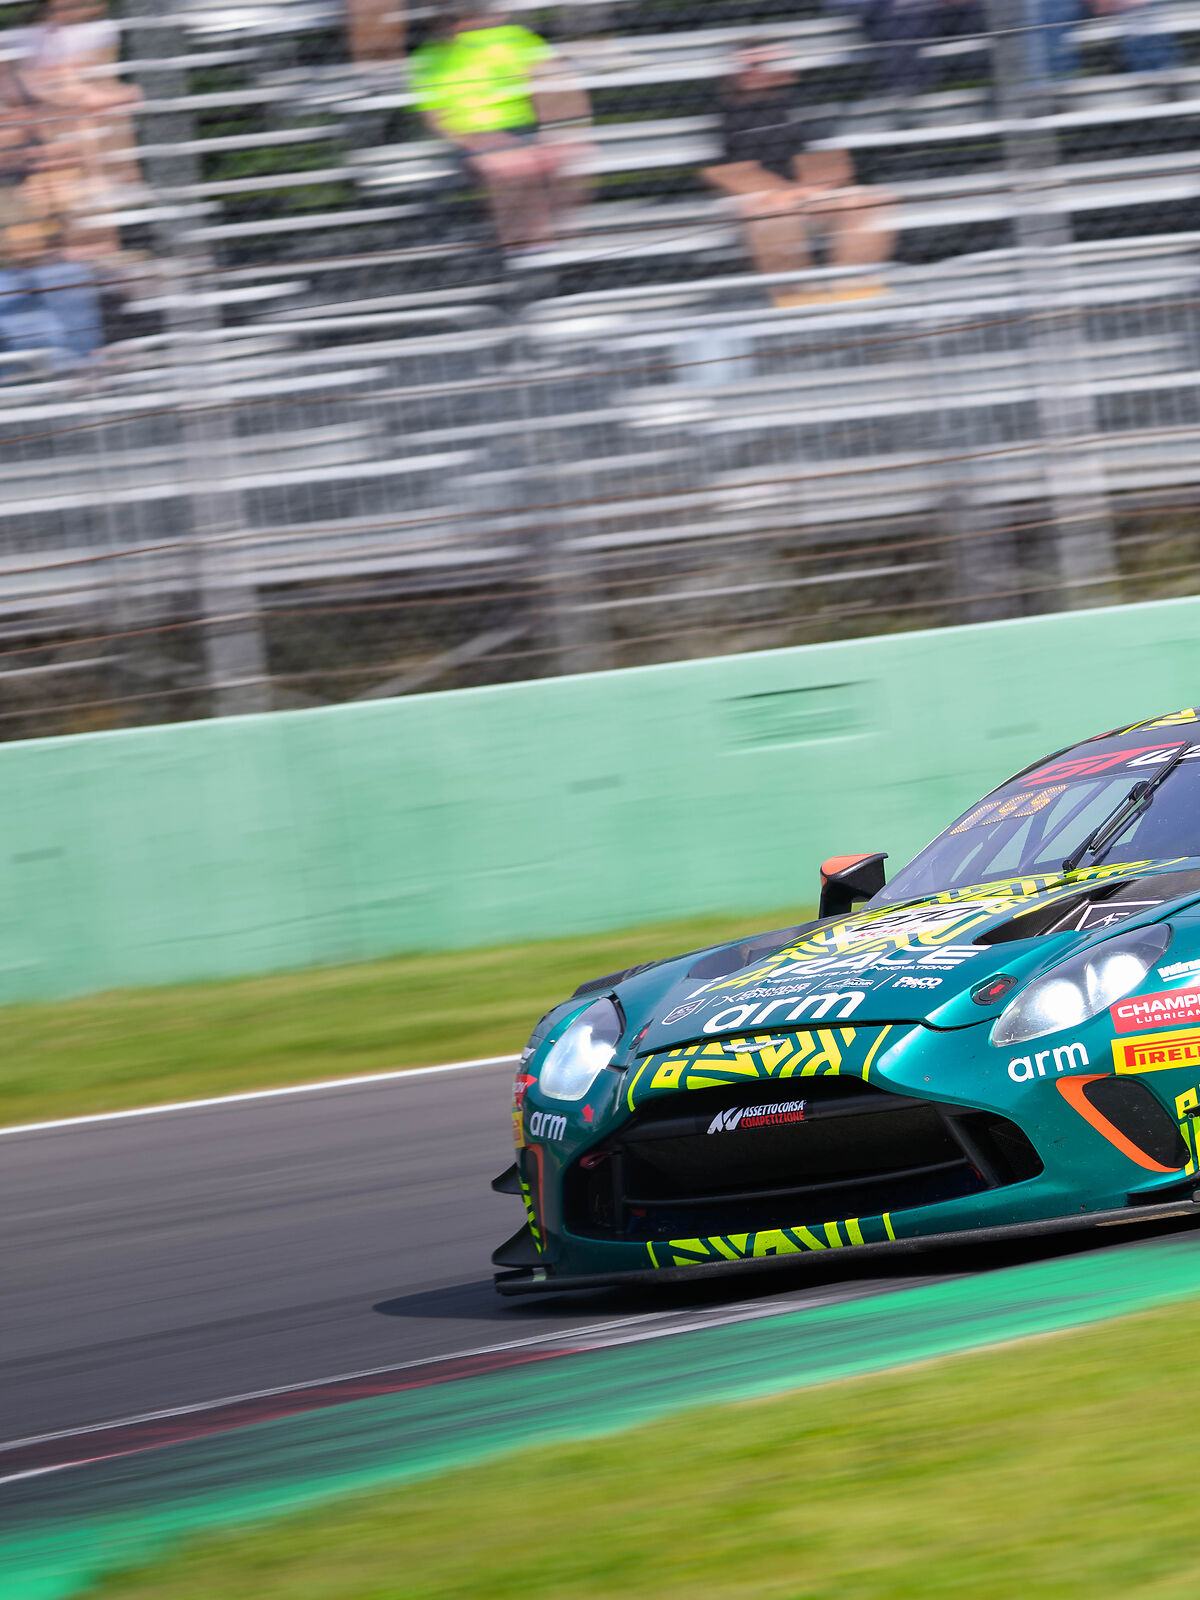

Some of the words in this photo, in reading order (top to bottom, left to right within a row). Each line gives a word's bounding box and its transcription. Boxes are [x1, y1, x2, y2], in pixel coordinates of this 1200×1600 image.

[1017, 741, 1187, 787] GT
[703, 990, 865, 1034] arm
[1007, 1042, 1090, 1083] arm
[530, 1111, 567, 1141] arm
[741, 1111, 805, 1128] COMPETIZIONE
[743, 1103, 778, 1118] ASSETTO
[778, 1100, 804, 1113] CORSA
